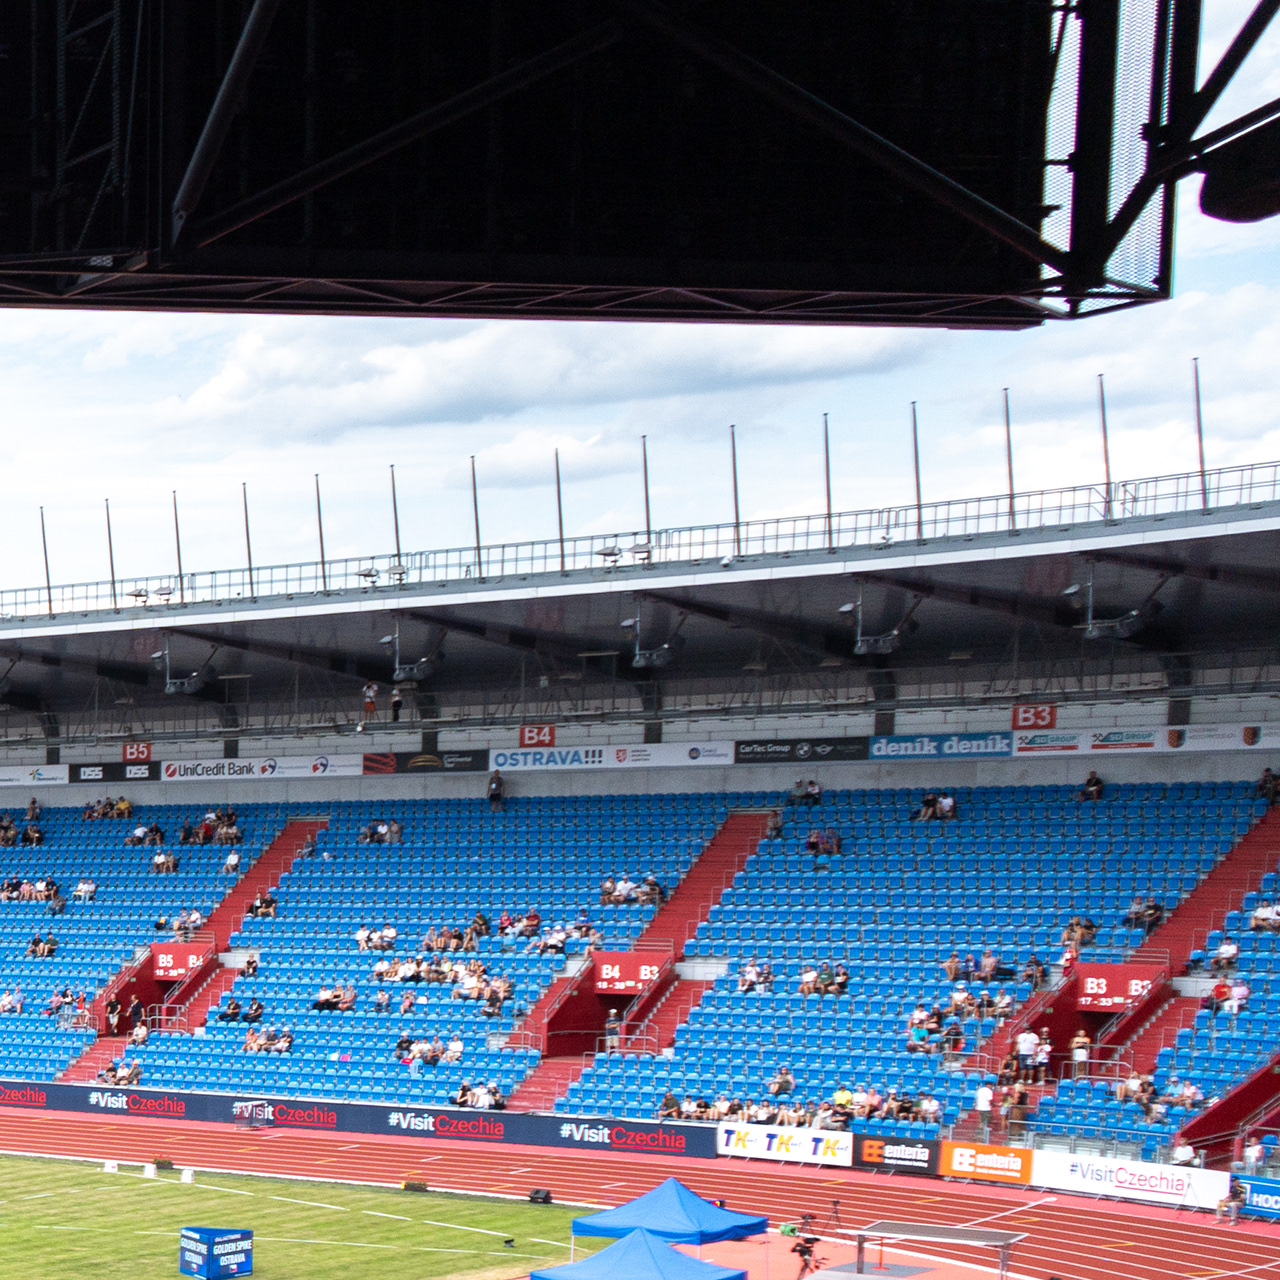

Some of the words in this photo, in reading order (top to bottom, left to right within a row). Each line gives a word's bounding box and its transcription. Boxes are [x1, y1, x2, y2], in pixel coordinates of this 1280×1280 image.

[1018, 707, 1051, 726] B3
[524, 727, 551, 744] B4
[126, 744, 148, 758] B5
[739, 744, 766, 753] CarTec
[767, 744, 791, 754] Group
[872, 737, 939, 756] deník
[943, 735, 1011, 754] deník
[494, 749, 603, 767] OSTRAVA!!!
[178, 762, 226, 777] UniCredit
[228, 762, 255, 776] Bank
[158, 954, 174, 967] B5
[601, 965, 621, 979] B4
[1085, 978, 1107, 994] B3
[89, 1091, 186, 1113] #VisitCzechia
[388, 1111, 504, 1136] #VisitCzechia
[560, 1123, 686, 1149] #VisitCzechia
[884, 1144, 930, 1160] enteria
[975, 1153, 1022, 1170] enteria
[1069, 1160, 1185, 1191] #VisitCzechia
[213, 1242, 236, 1255] GOLDEN
[236, 1239, 253, 1251] SPIKE
[220, 1252, 246, 1266] OSTRAVA
